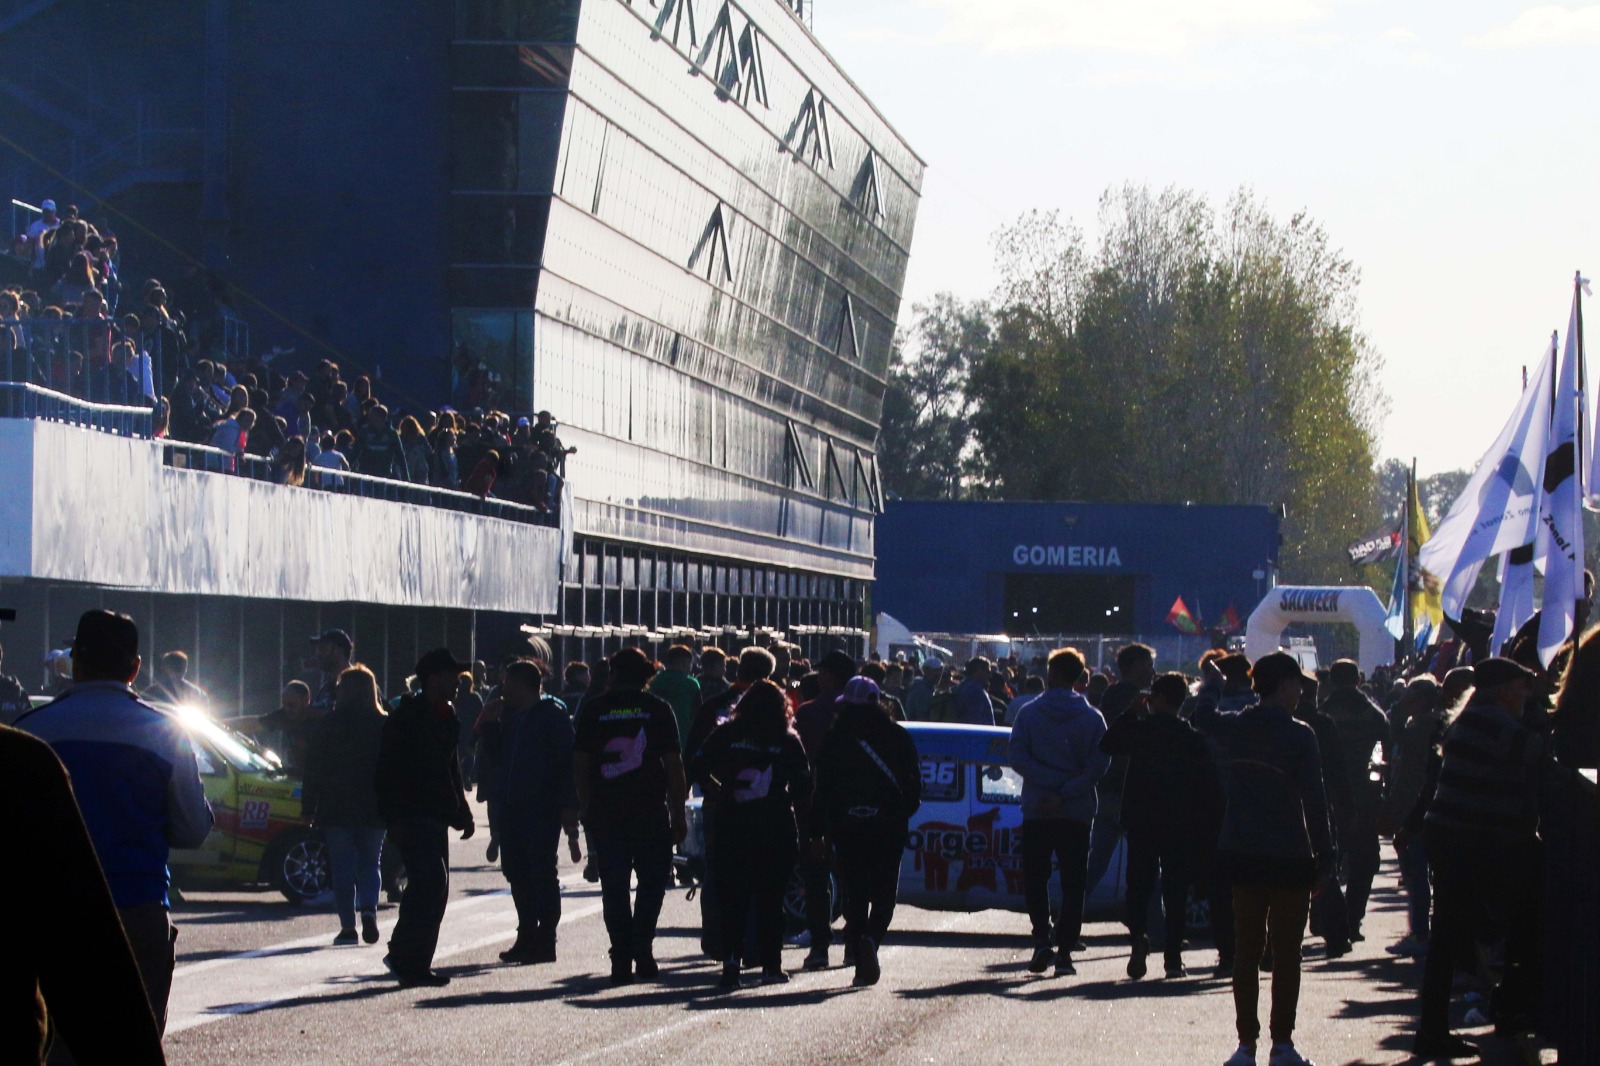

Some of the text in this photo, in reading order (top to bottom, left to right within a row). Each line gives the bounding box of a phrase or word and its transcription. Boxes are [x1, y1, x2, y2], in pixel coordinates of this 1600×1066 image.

[1542, 513, 1571, 551] Zonal
[1012, 544, 1121, 566] GOMERIA
[242, 800, 270, 820] RB
